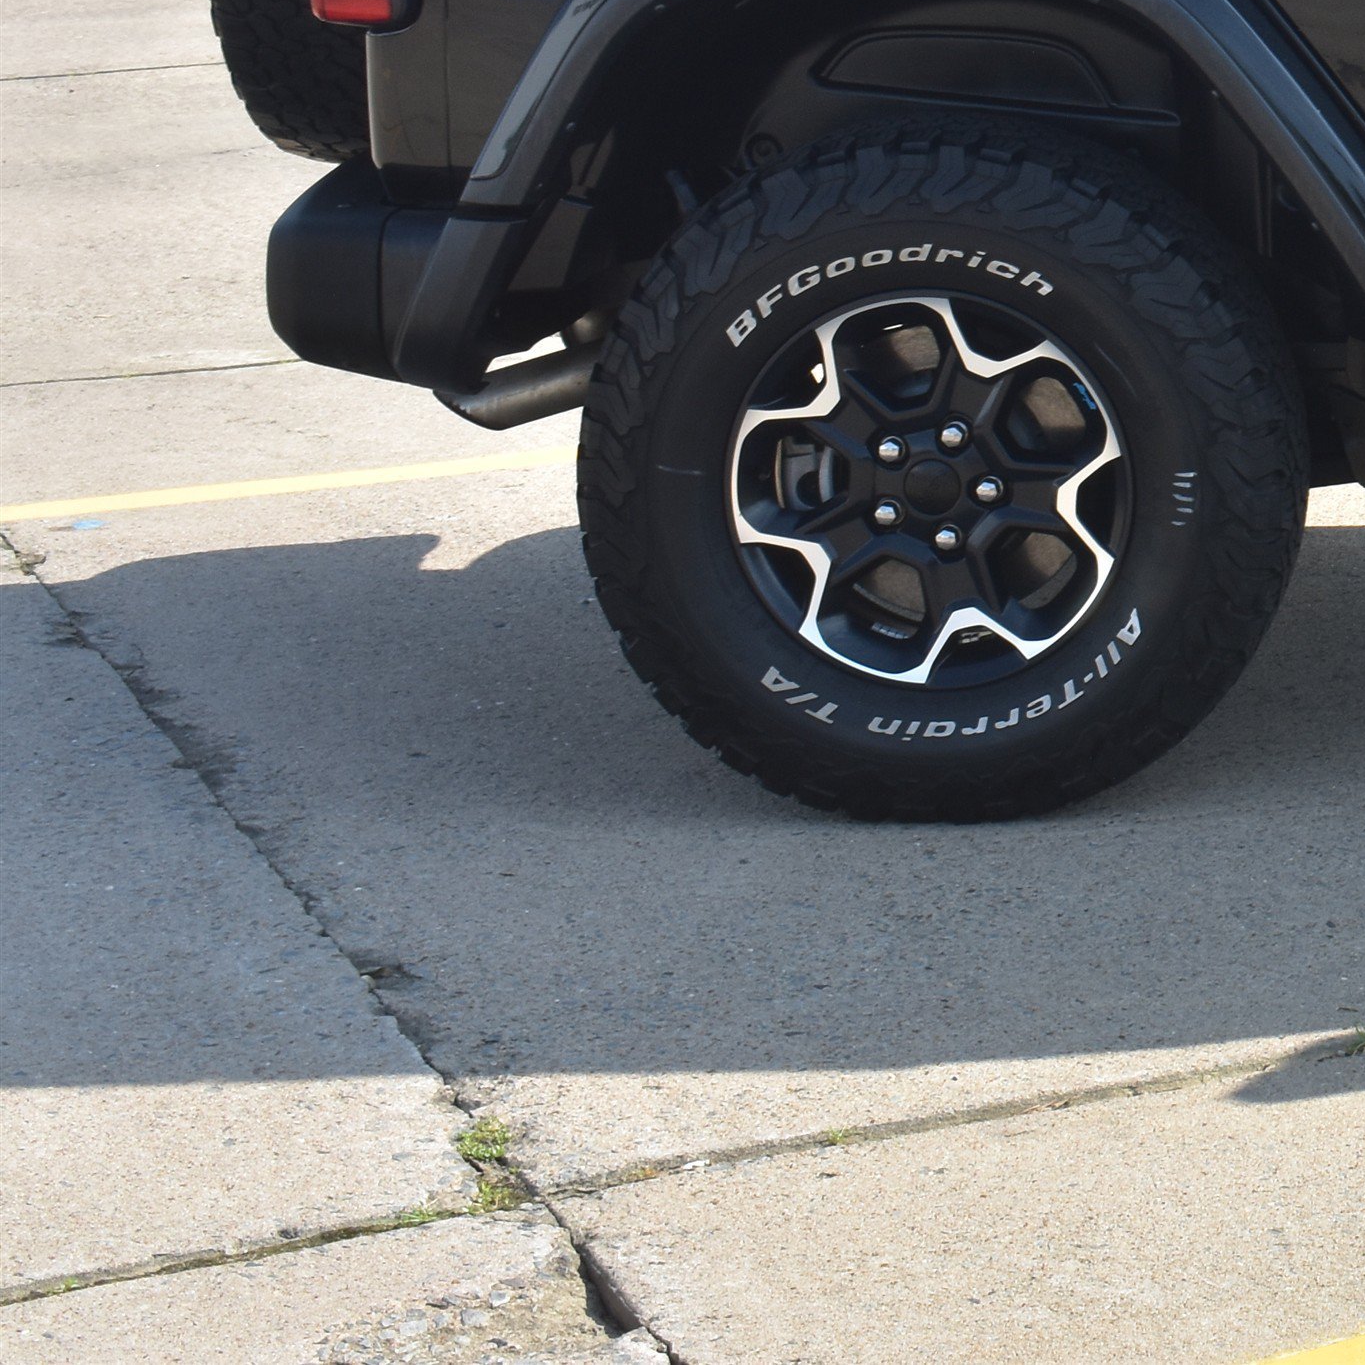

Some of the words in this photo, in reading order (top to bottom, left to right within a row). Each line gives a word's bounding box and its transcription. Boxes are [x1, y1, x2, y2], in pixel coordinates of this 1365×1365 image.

[725, 242, 1055, 347] BFGoodrich
[759, 665, 842, 725] T/A
[867, 608, 1143, 742] All-Terrain
